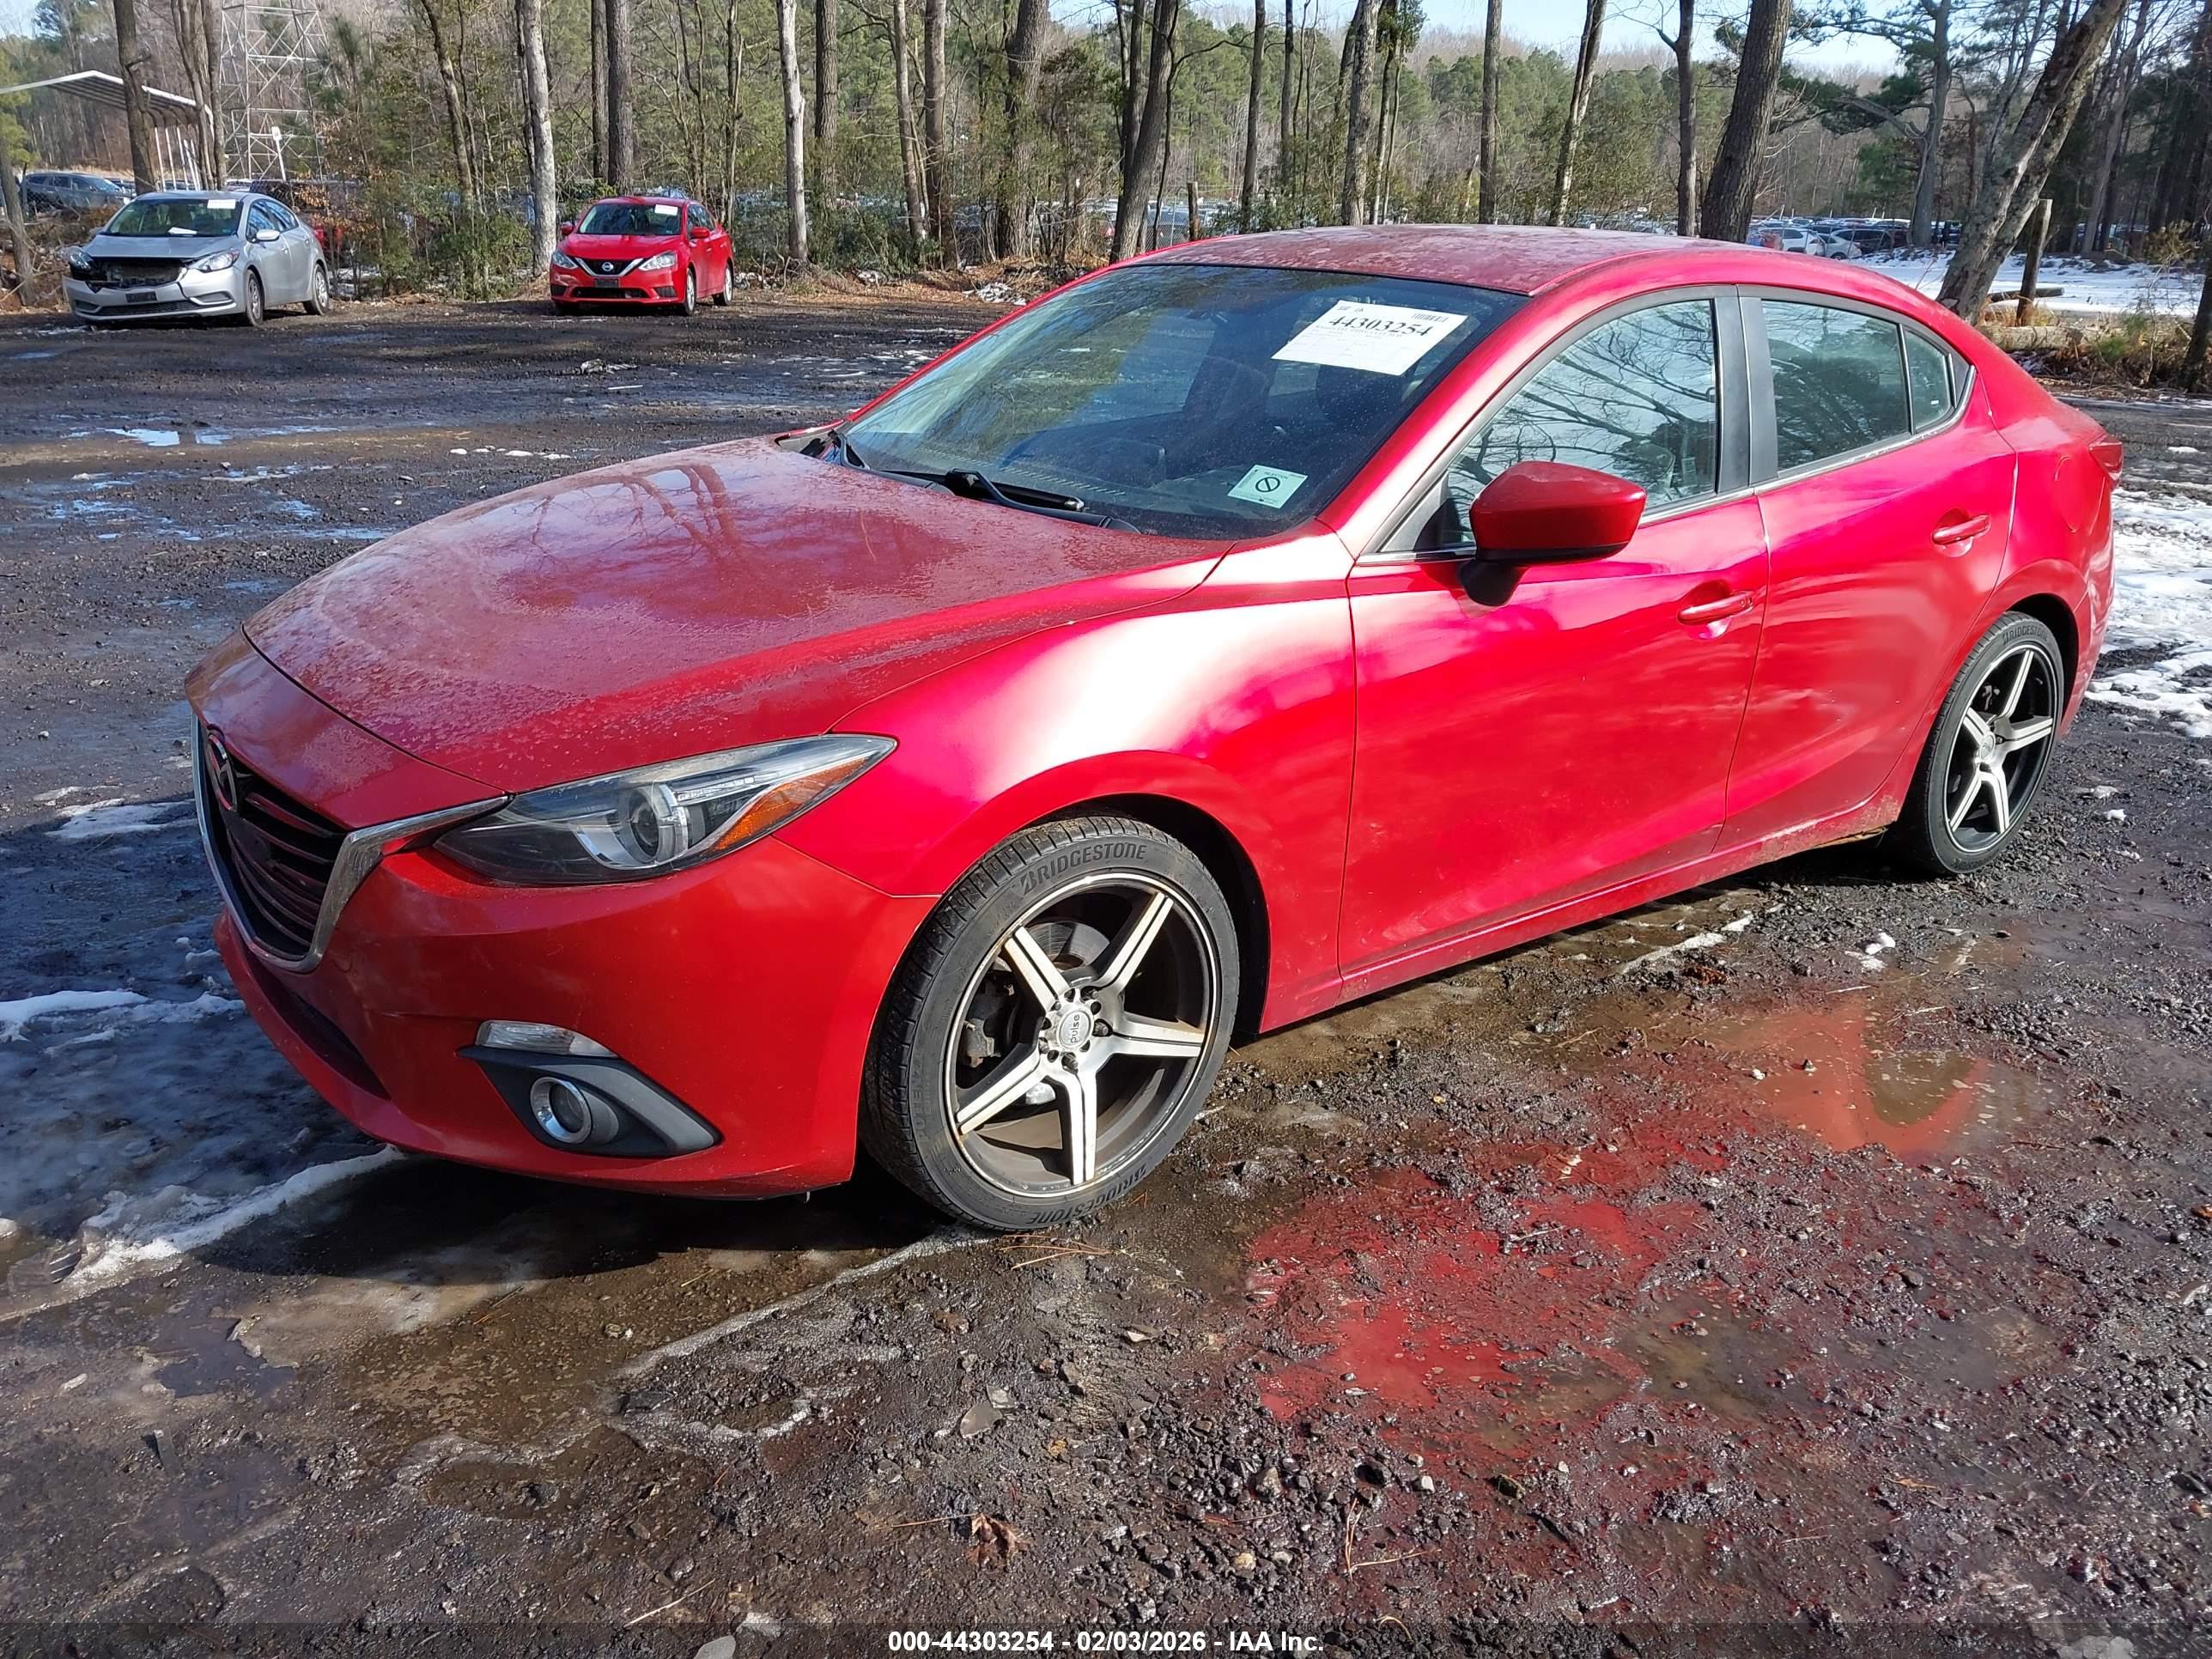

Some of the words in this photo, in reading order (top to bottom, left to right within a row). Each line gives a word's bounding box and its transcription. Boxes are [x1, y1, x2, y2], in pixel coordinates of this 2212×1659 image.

[1329, 315, 1433, 337] 44303254
[1019, 842, 1147, 896] BRIDGESTONE
[1071, 1014, 1080, 1043] pulse
